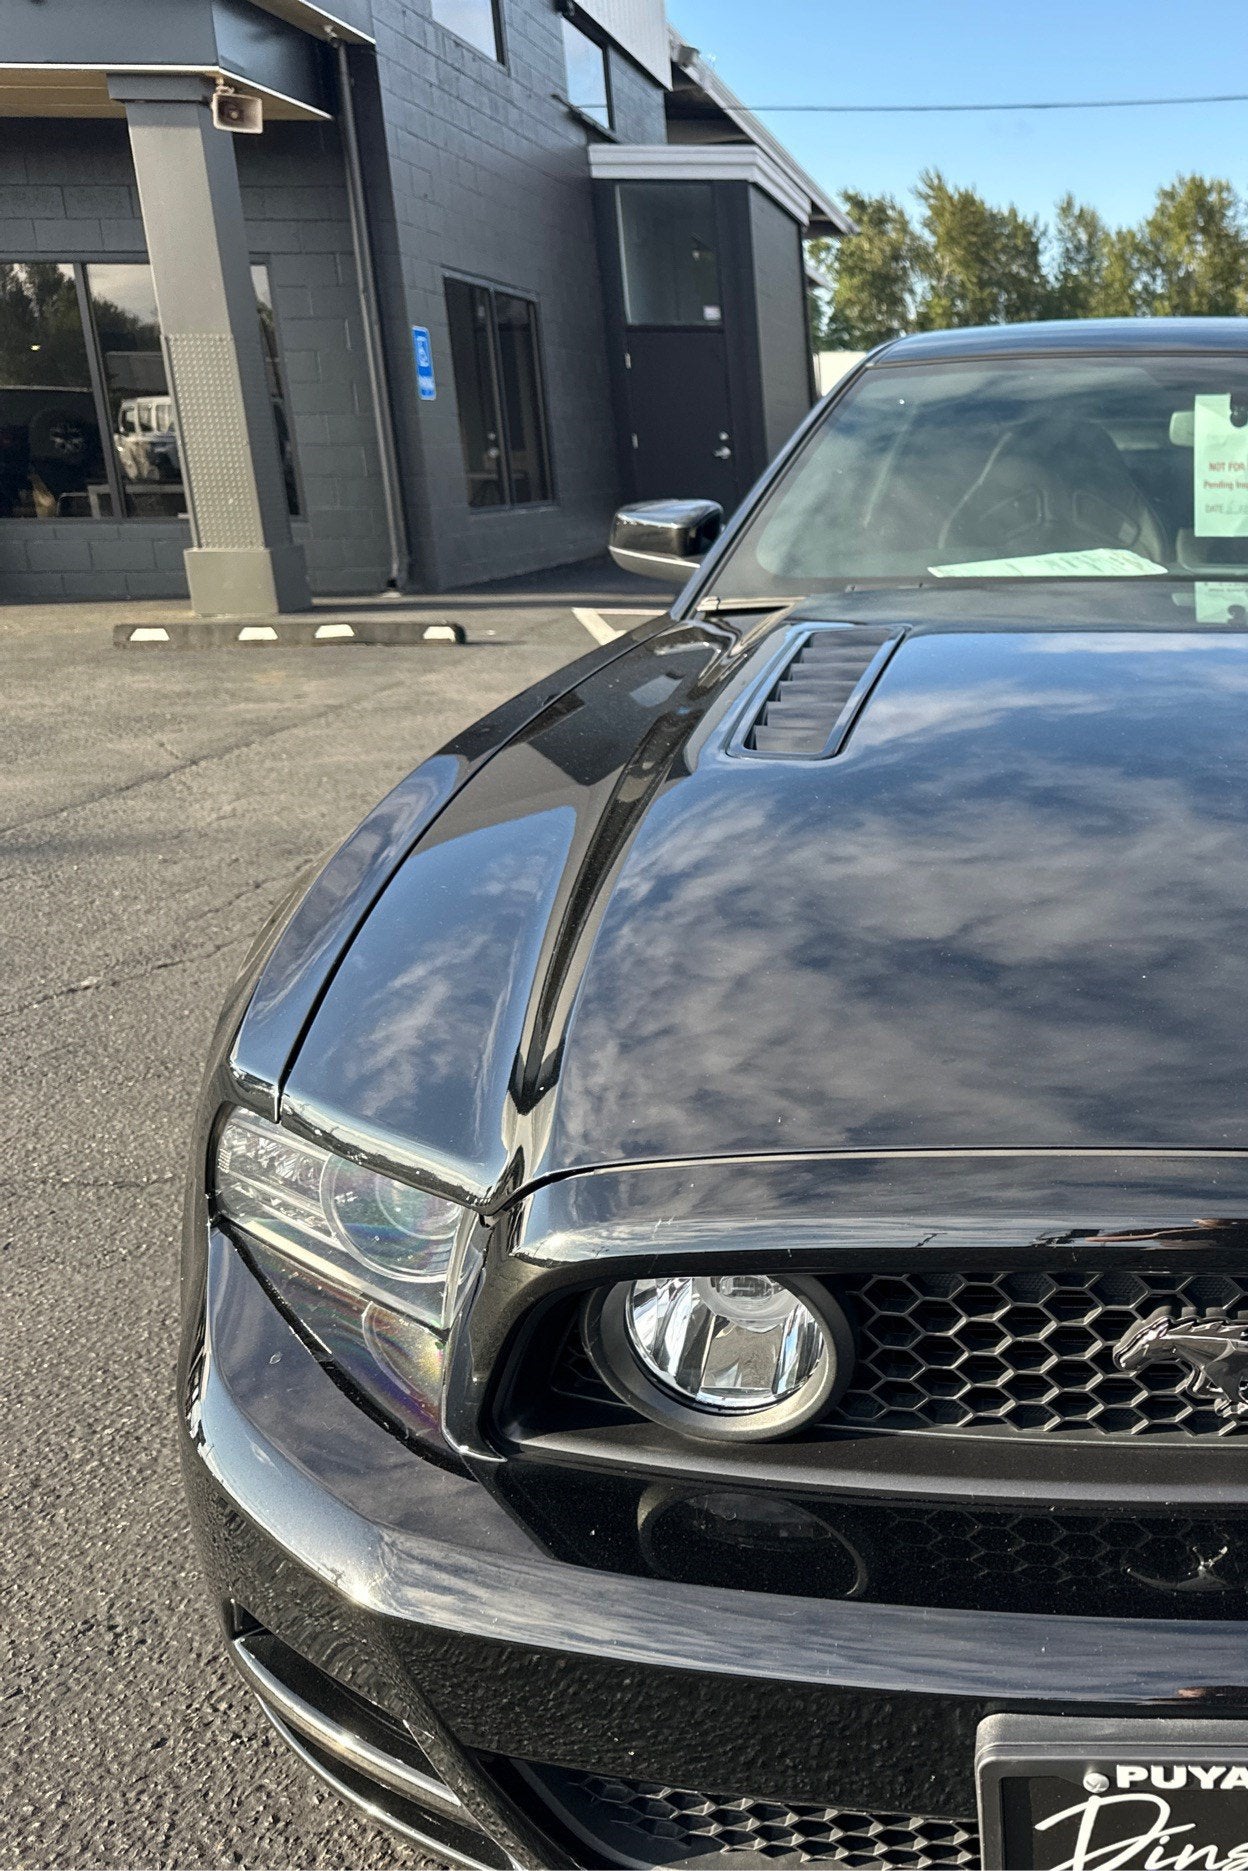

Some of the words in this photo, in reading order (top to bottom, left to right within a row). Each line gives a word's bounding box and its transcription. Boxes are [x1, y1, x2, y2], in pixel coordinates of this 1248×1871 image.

[1208, 462, 1225, 472] NOT
[1228, 462, 1245, 471] FOR
[1203, 480, 1234, 491] Pending
